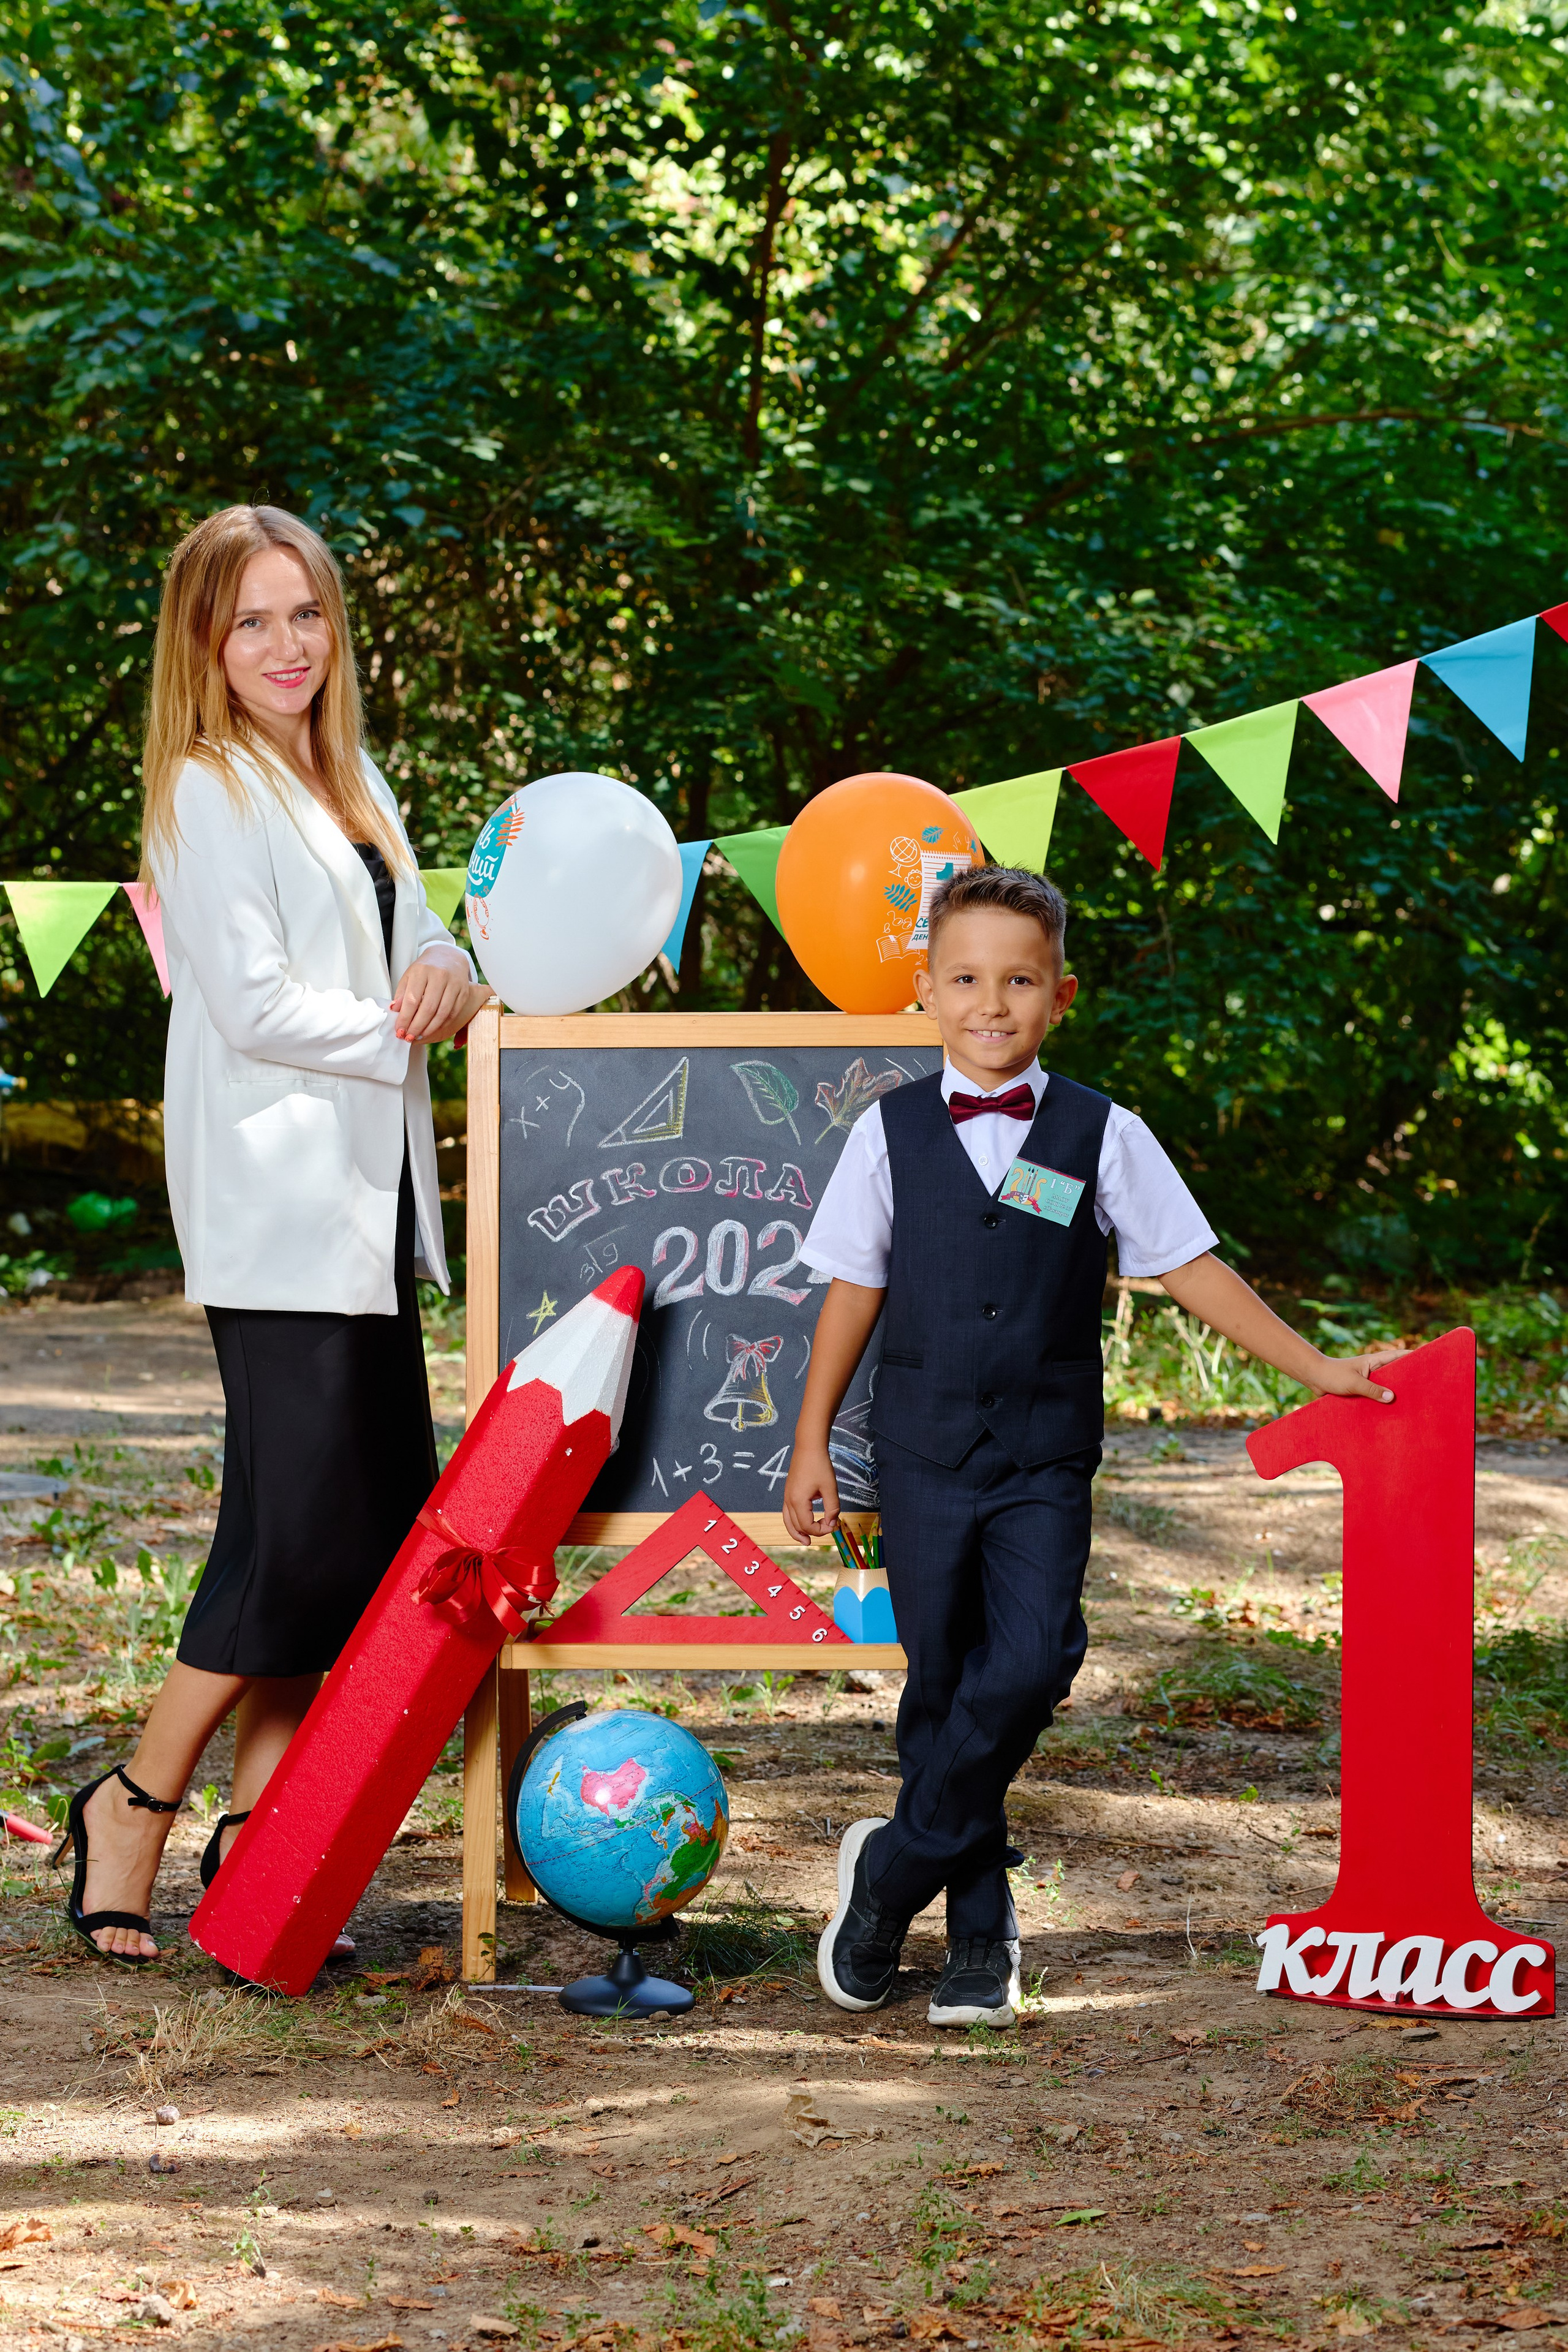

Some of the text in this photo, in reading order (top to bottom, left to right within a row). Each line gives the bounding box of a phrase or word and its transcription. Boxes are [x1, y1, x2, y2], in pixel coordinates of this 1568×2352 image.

[527, 1156, 813, 1242] ШКОЛА
[652, 1218, 833, 1310] 202
[703, 1519, 717, 1532] 1
[721, 1538, 738, 1555] 2
[744, 1560, 760, 1575] 3
[767, 1584, 783, 1599] 4
[789, 1605, 806, 1620] 5
[812, 1627, 828, 1642] 6
[1256, 1923, 1547, 2013] класс
